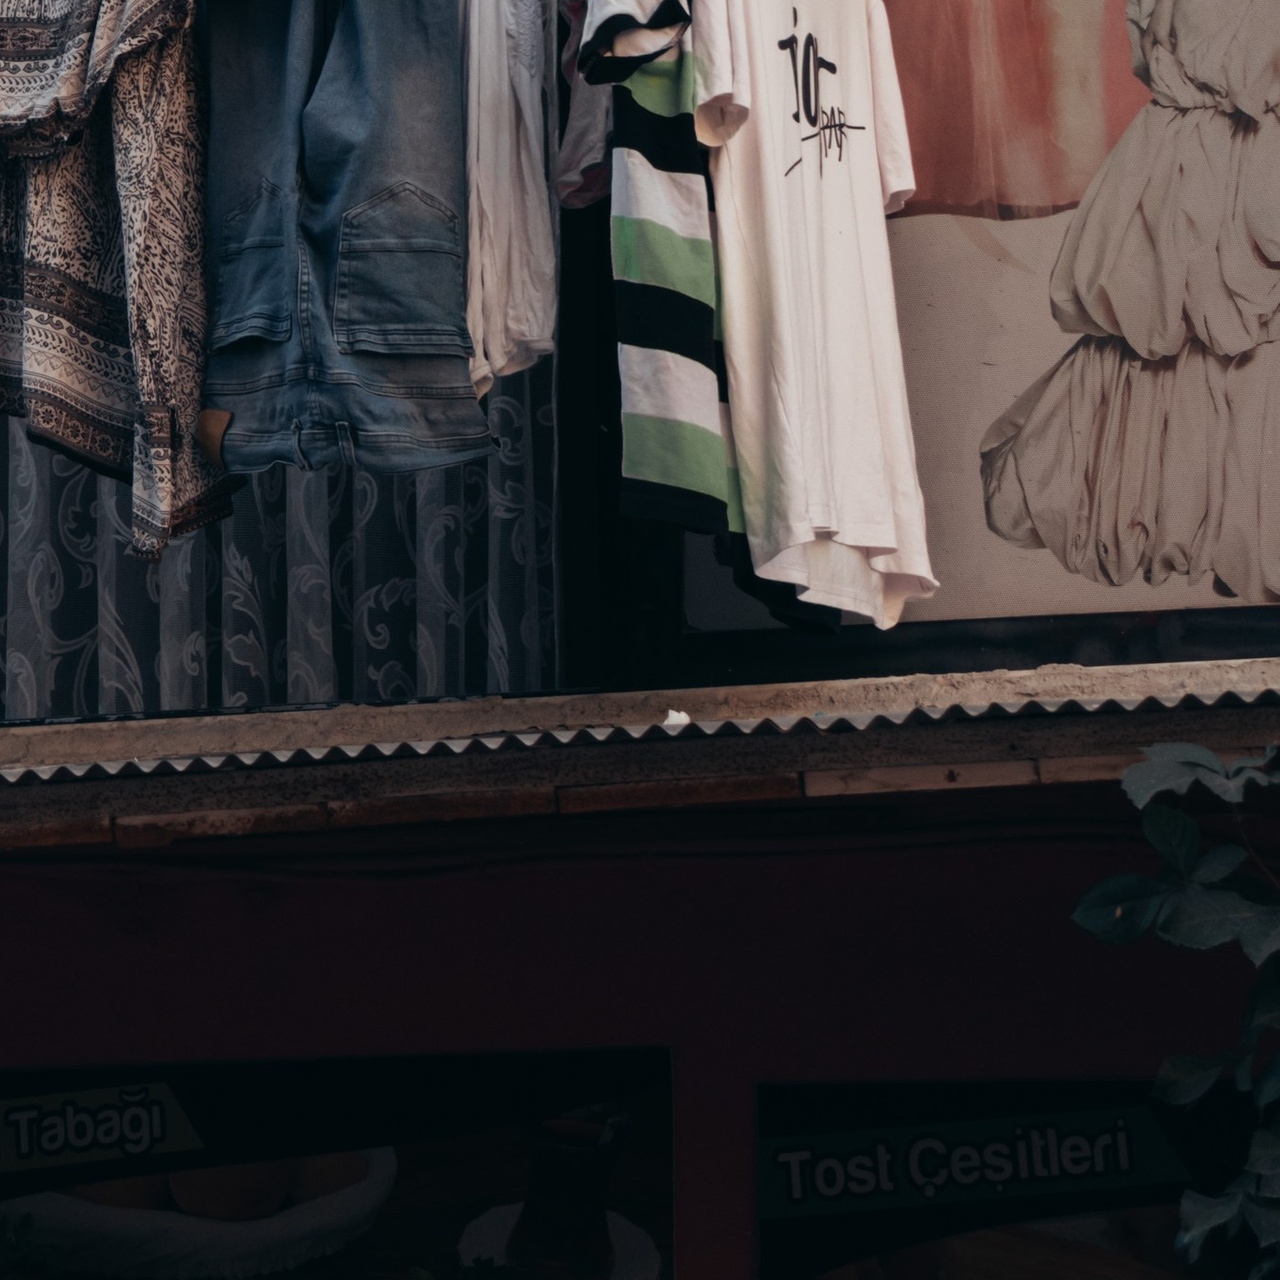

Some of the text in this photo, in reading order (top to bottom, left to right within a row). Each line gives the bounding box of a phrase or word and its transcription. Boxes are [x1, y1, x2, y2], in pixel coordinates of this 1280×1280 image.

[7, 1090, 164, 1156] Tabağı
[776, 1117, 1132, 1200] Tost Çeşitleri
